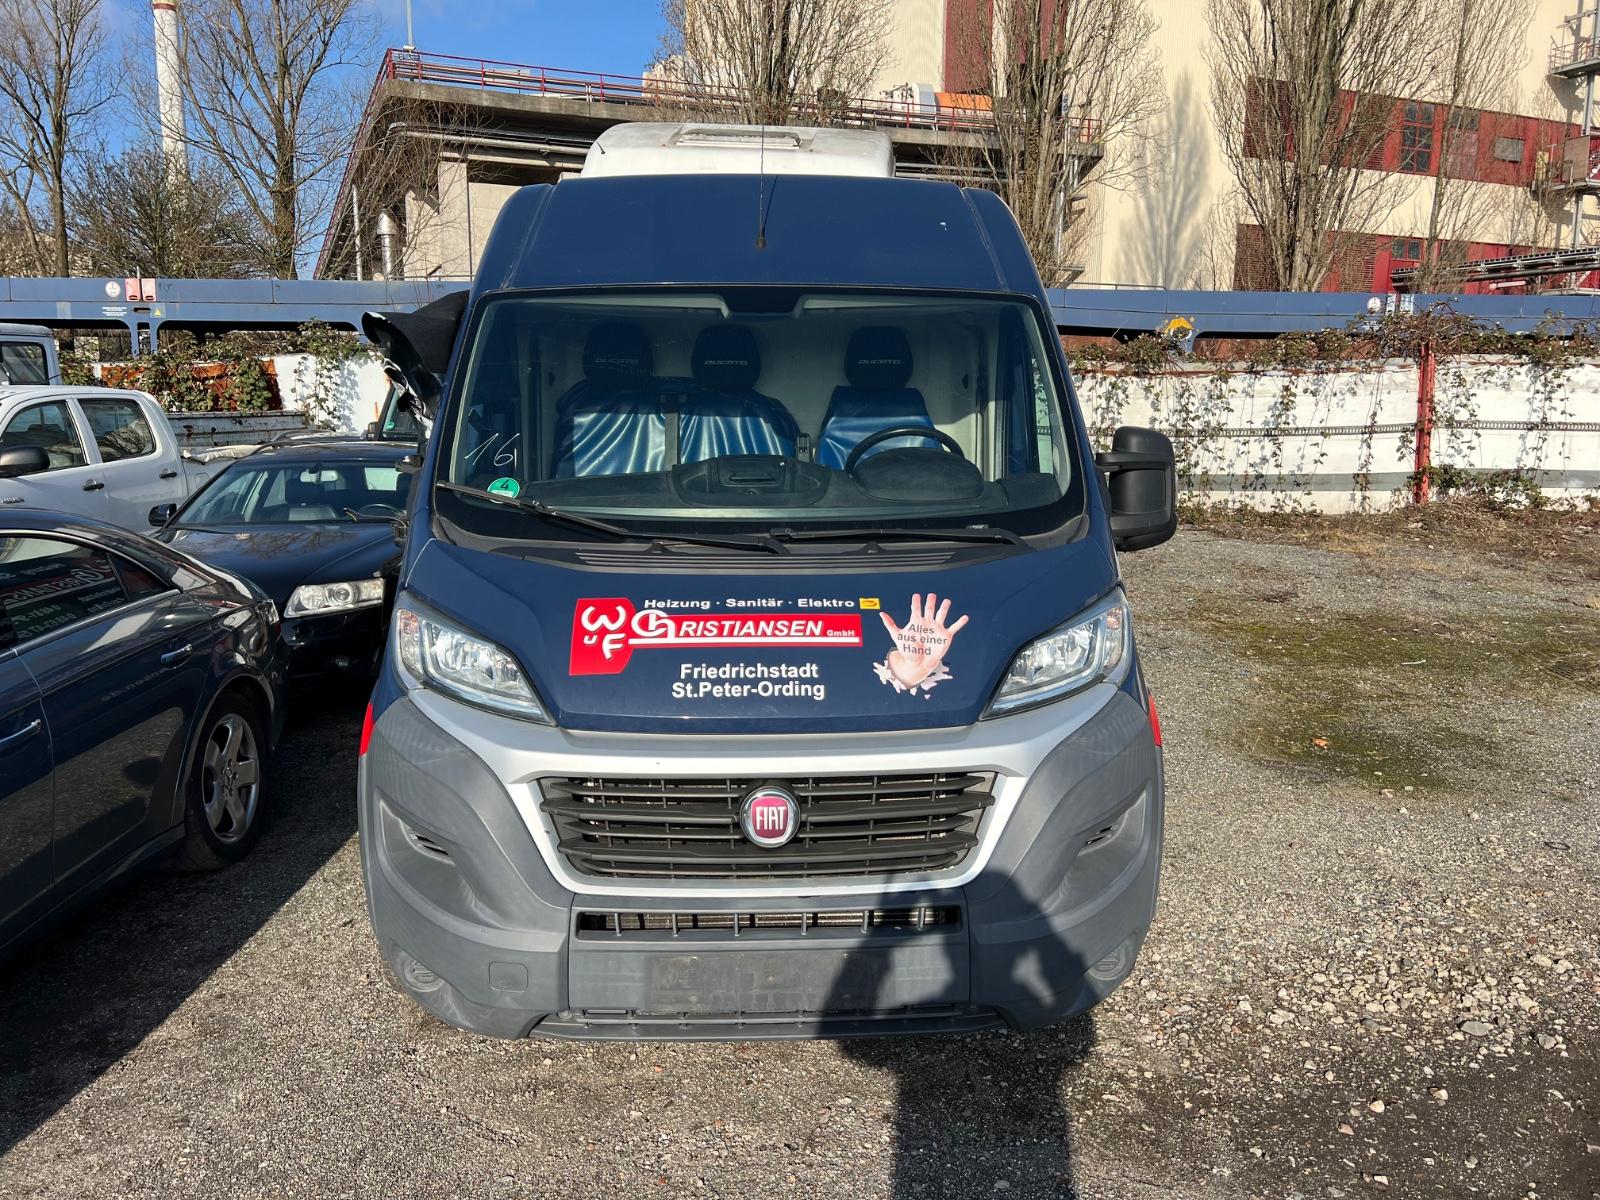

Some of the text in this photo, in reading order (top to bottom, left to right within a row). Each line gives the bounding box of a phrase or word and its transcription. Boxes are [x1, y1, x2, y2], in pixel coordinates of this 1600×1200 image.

[500, 479, 509, 490] 4
[644, 598, 855, 610] Heizung Sanitär Elektro
[826, 629, 855, 637] GmbH
[908, 623, 935, 634] Alles
[897, 633, 948, 645] aus einer
[903, 643, 932, 655] Hand
[680, 662, 819, 679] Friedrichstadt
[672, 680, 825, 700] St.Peter-Ording
[756, 806, 786, 830] FIAT
